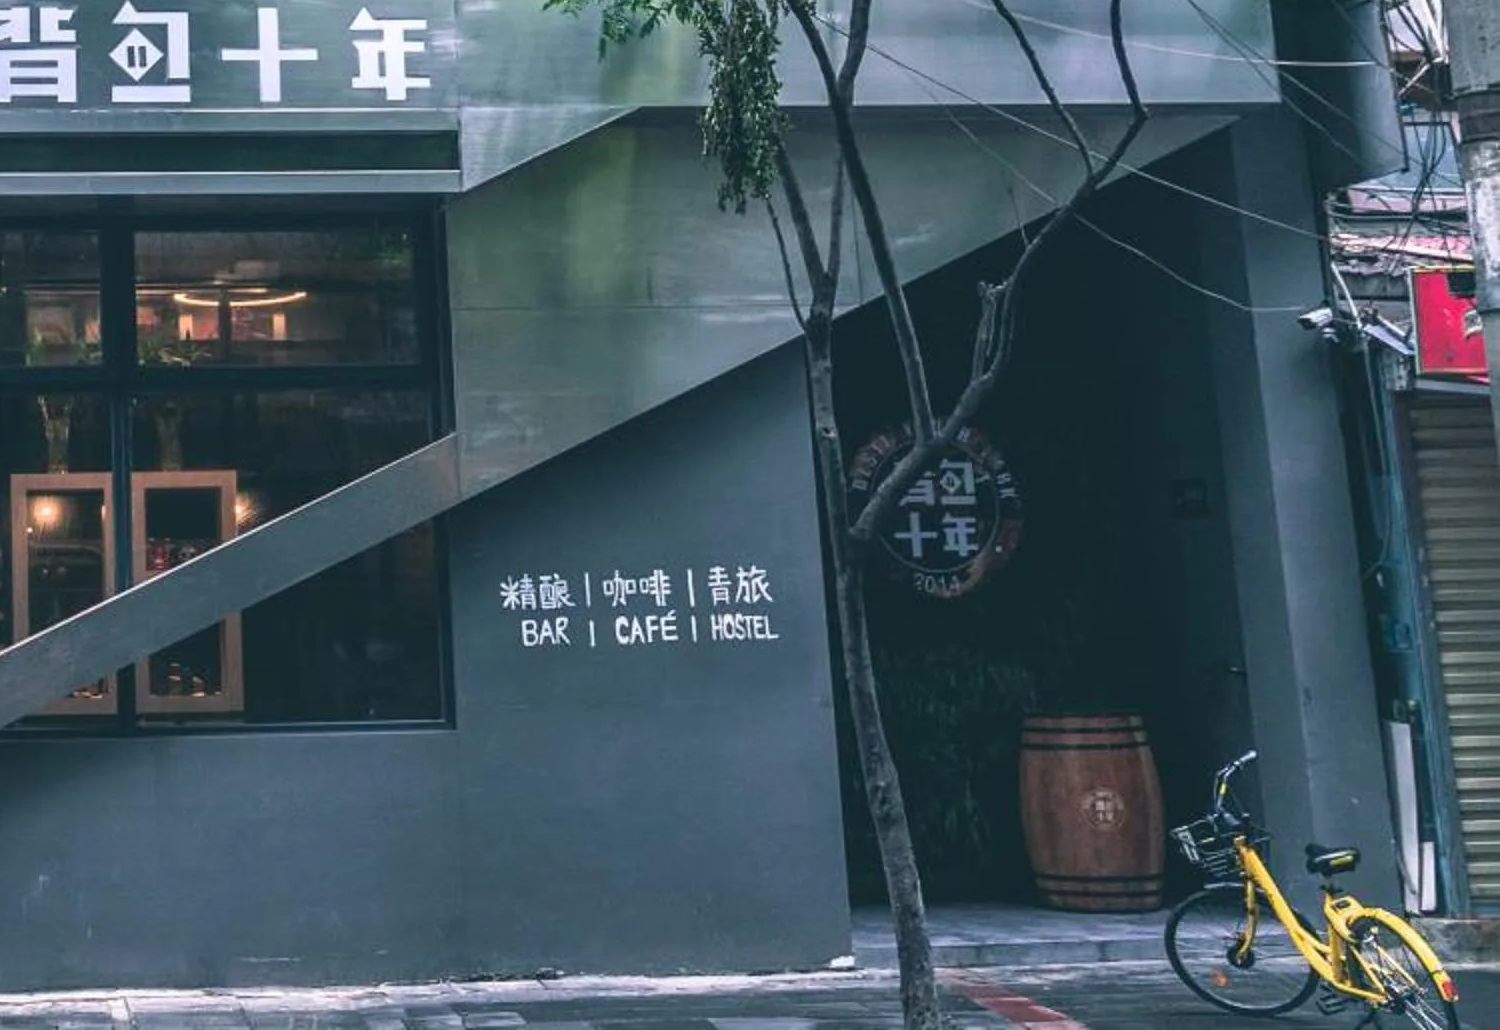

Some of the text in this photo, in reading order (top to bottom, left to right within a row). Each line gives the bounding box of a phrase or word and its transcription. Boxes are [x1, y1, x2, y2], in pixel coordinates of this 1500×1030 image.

[499, 565, 774, 610] 精酿 咖啡 青旅
[521, 609, 780, 647] BAR CAFÉ HOSTEL
